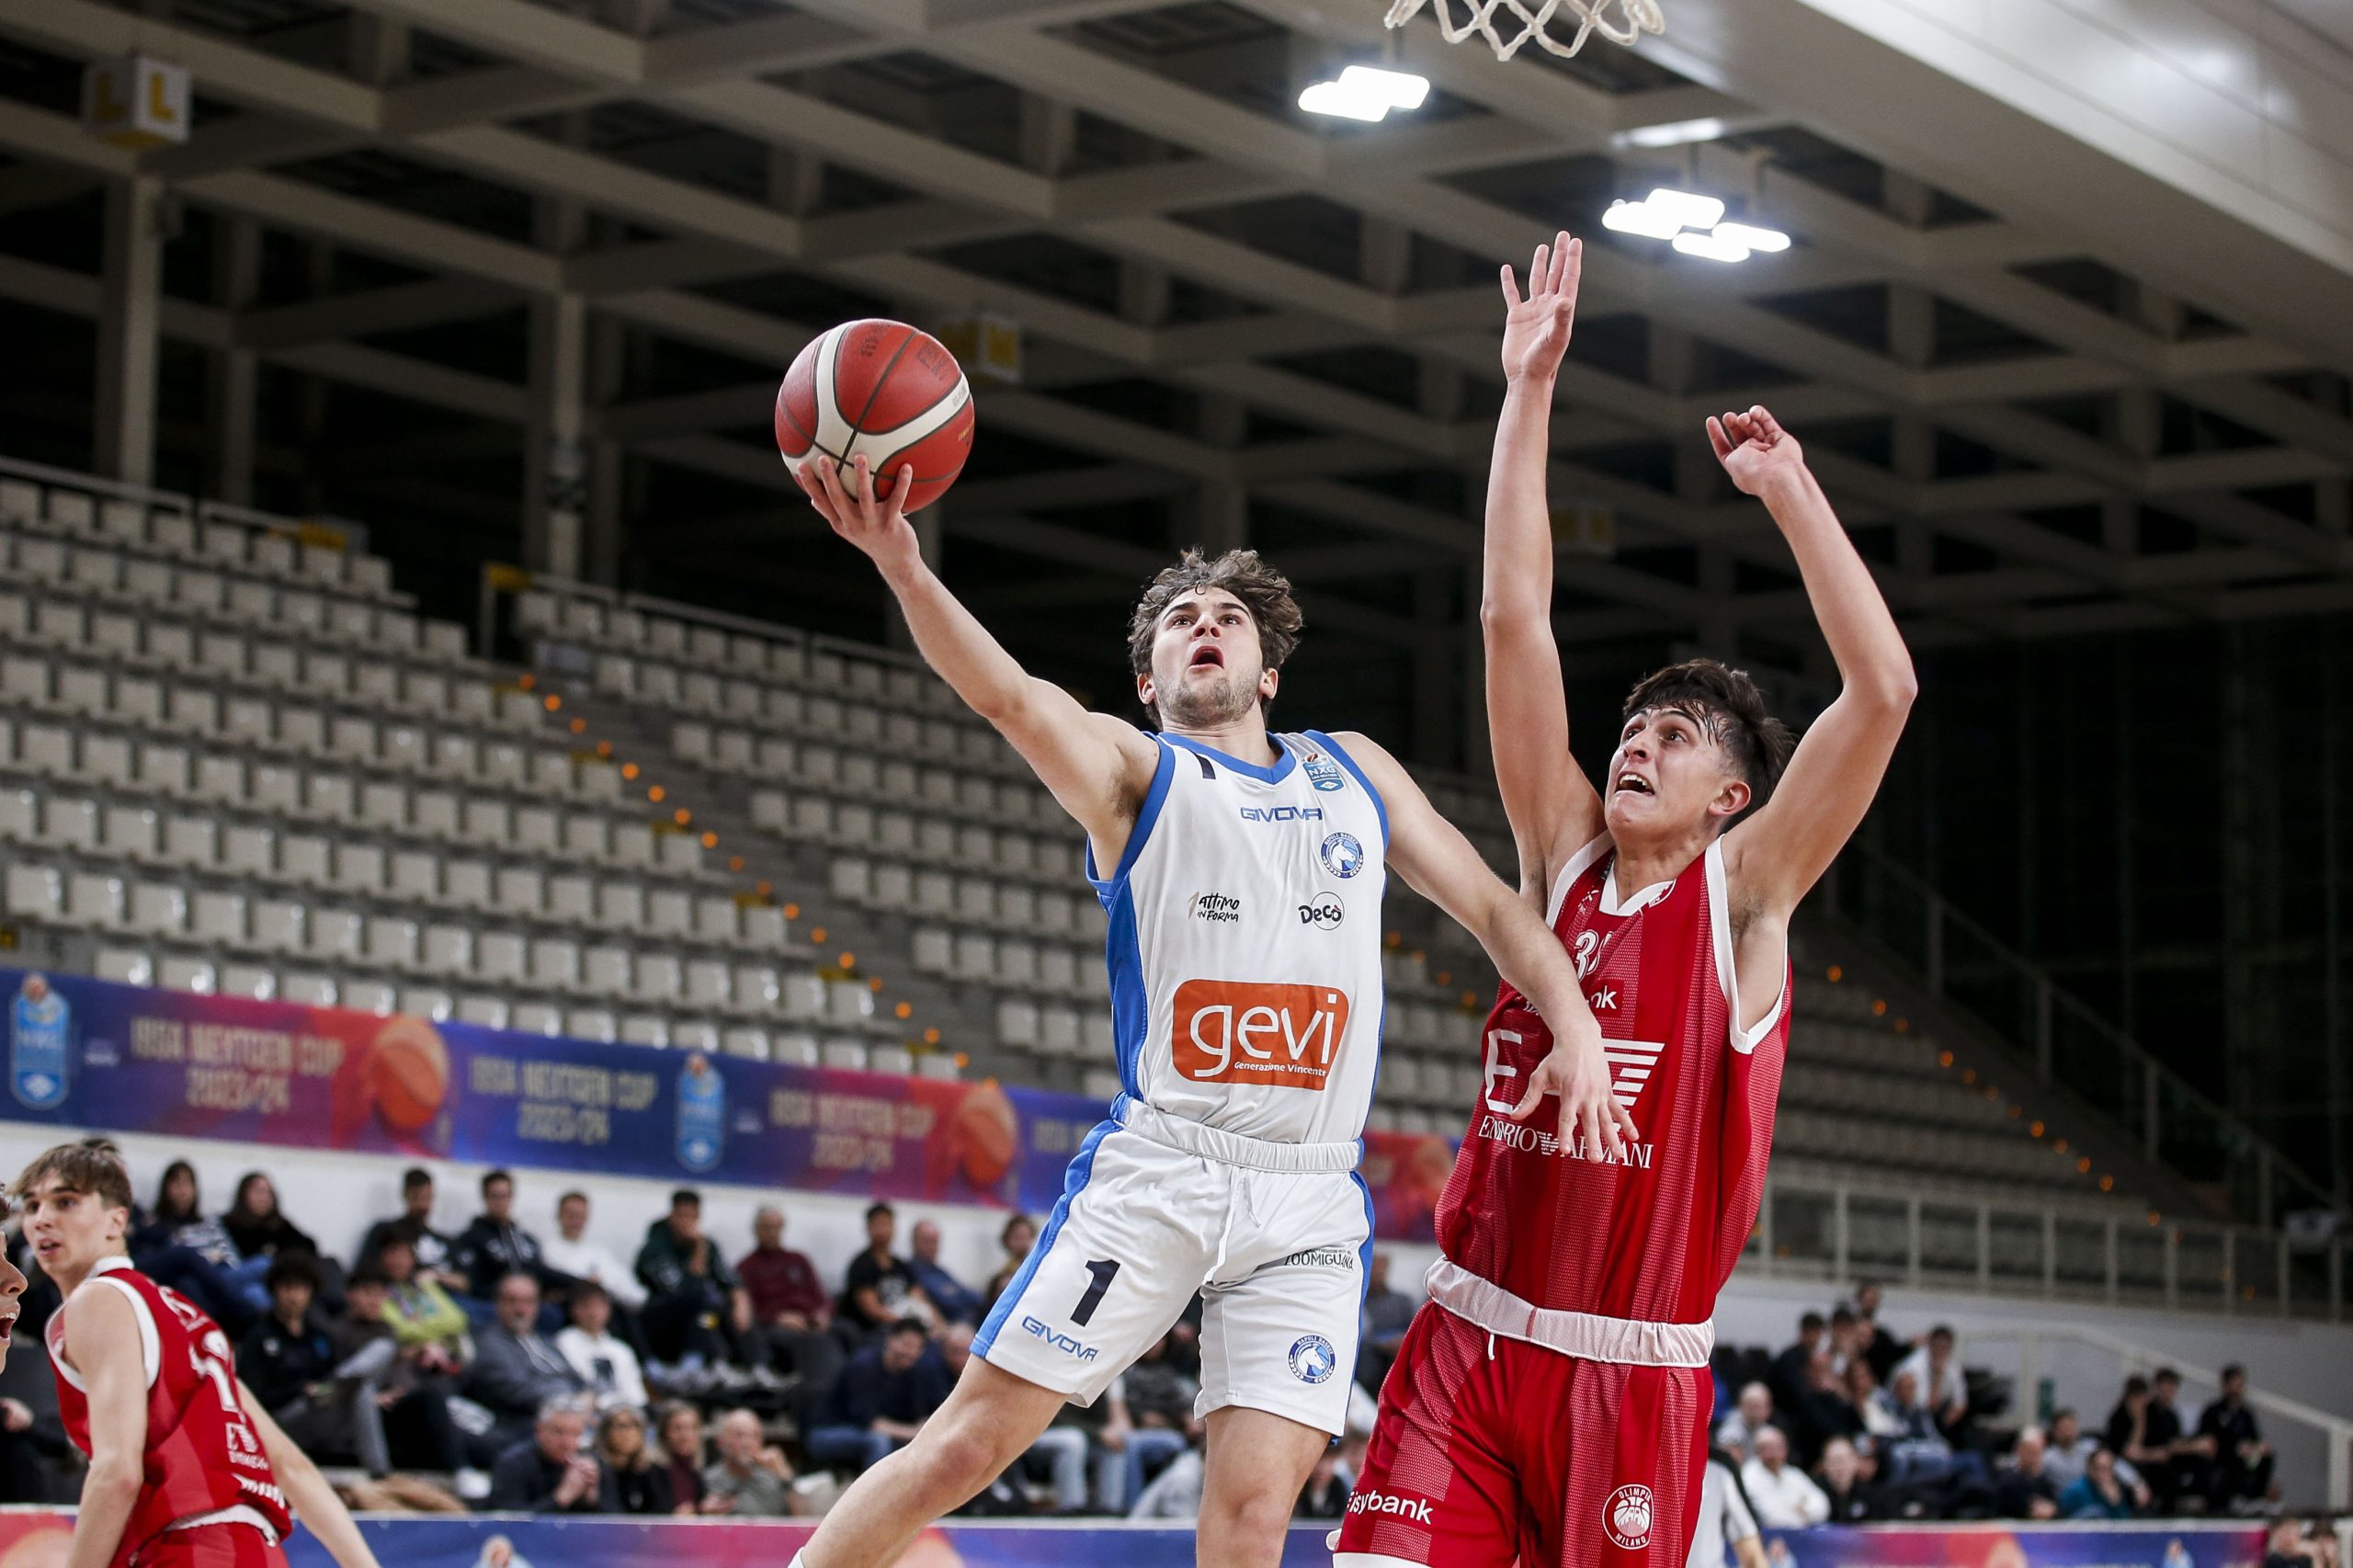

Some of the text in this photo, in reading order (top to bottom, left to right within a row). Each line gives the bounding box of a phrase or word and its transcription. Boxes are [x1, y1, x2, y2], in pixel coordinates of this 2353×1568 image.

[149, 73, 176, 122] L
[1240, 806, 1323, 823] GIVOVA
[1189, 994, 1337, 1077] gevi
[1234, 1062, 1326, 1076] Generazione Vincente
[1069, 1258, 1120, 1327] 1
[1022, 1315, 1099, 1362] GIVOVA
[1349, 1490, 1434, 1526] isybank
[1618, 1487, 1651, 1503] OLIMPIA
[1615, 1533, 1646, 1546] MILANO
